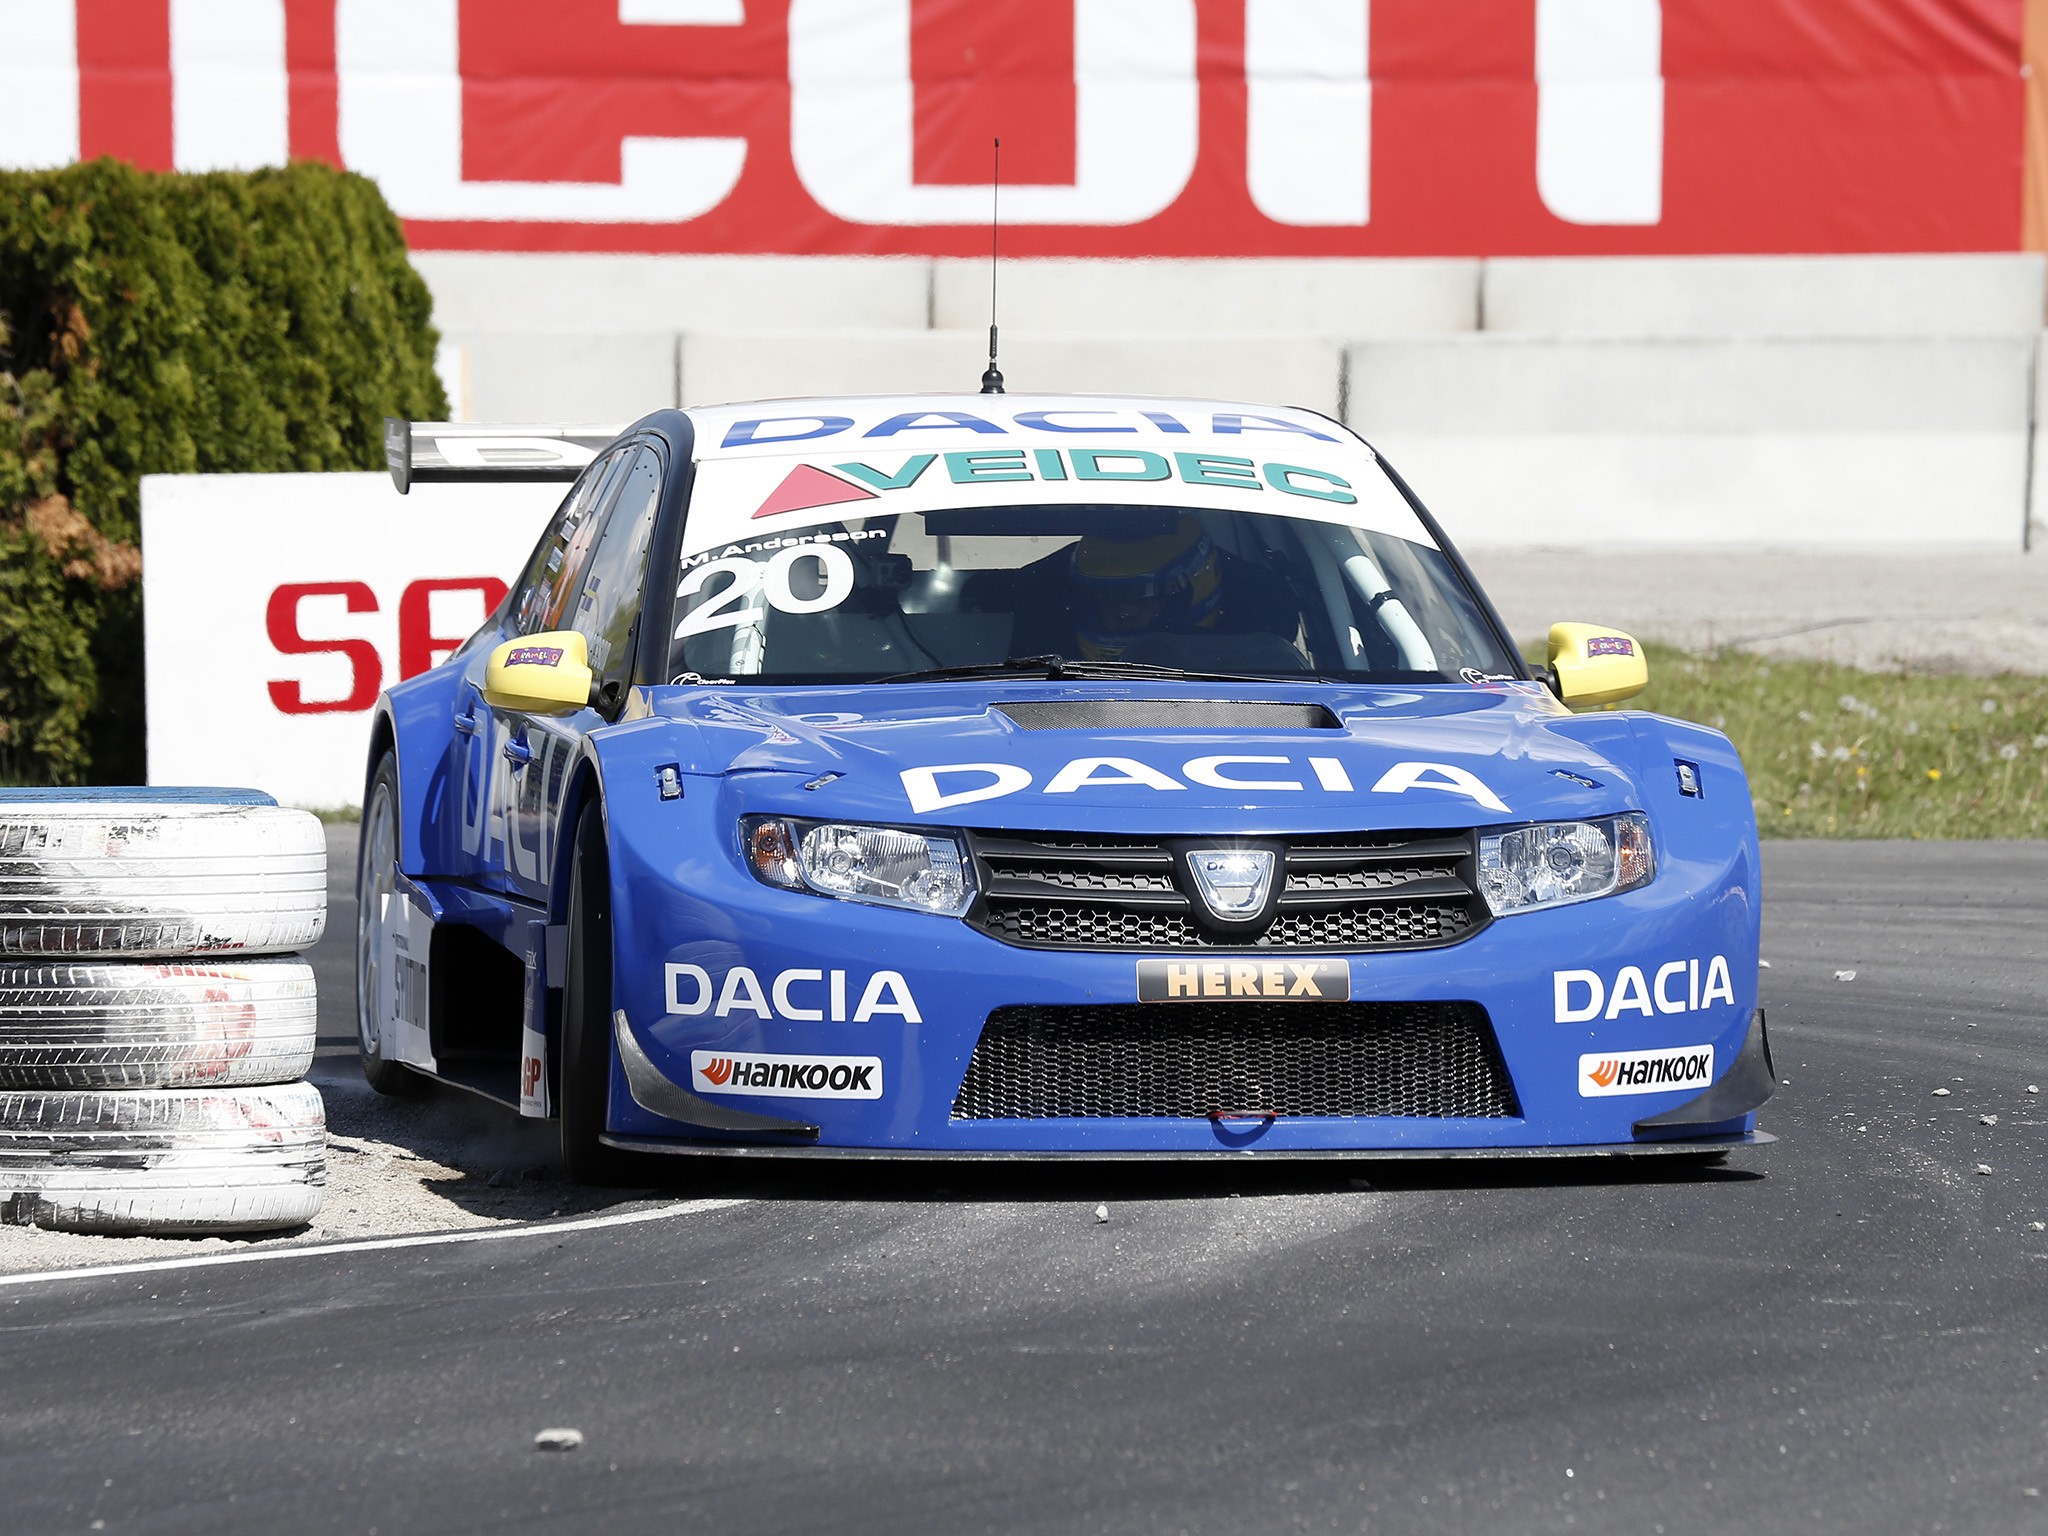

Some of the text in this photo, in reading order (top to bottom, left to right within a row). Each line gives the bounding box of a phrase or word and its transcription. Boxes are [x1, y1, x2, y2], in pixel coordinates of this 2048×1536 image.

[720, 410, 1344, 449] DACIA
[832, 448, 1358, 505] VEIDEC
[680, 528, 887, 570] M.Andersson
[674, 543, 855, 641] 20
[899, 755, 1512, 814] DACIA
[665, 962, 923, 1024] DACIA
[1553, 954, 1735, 1024] DACIA
